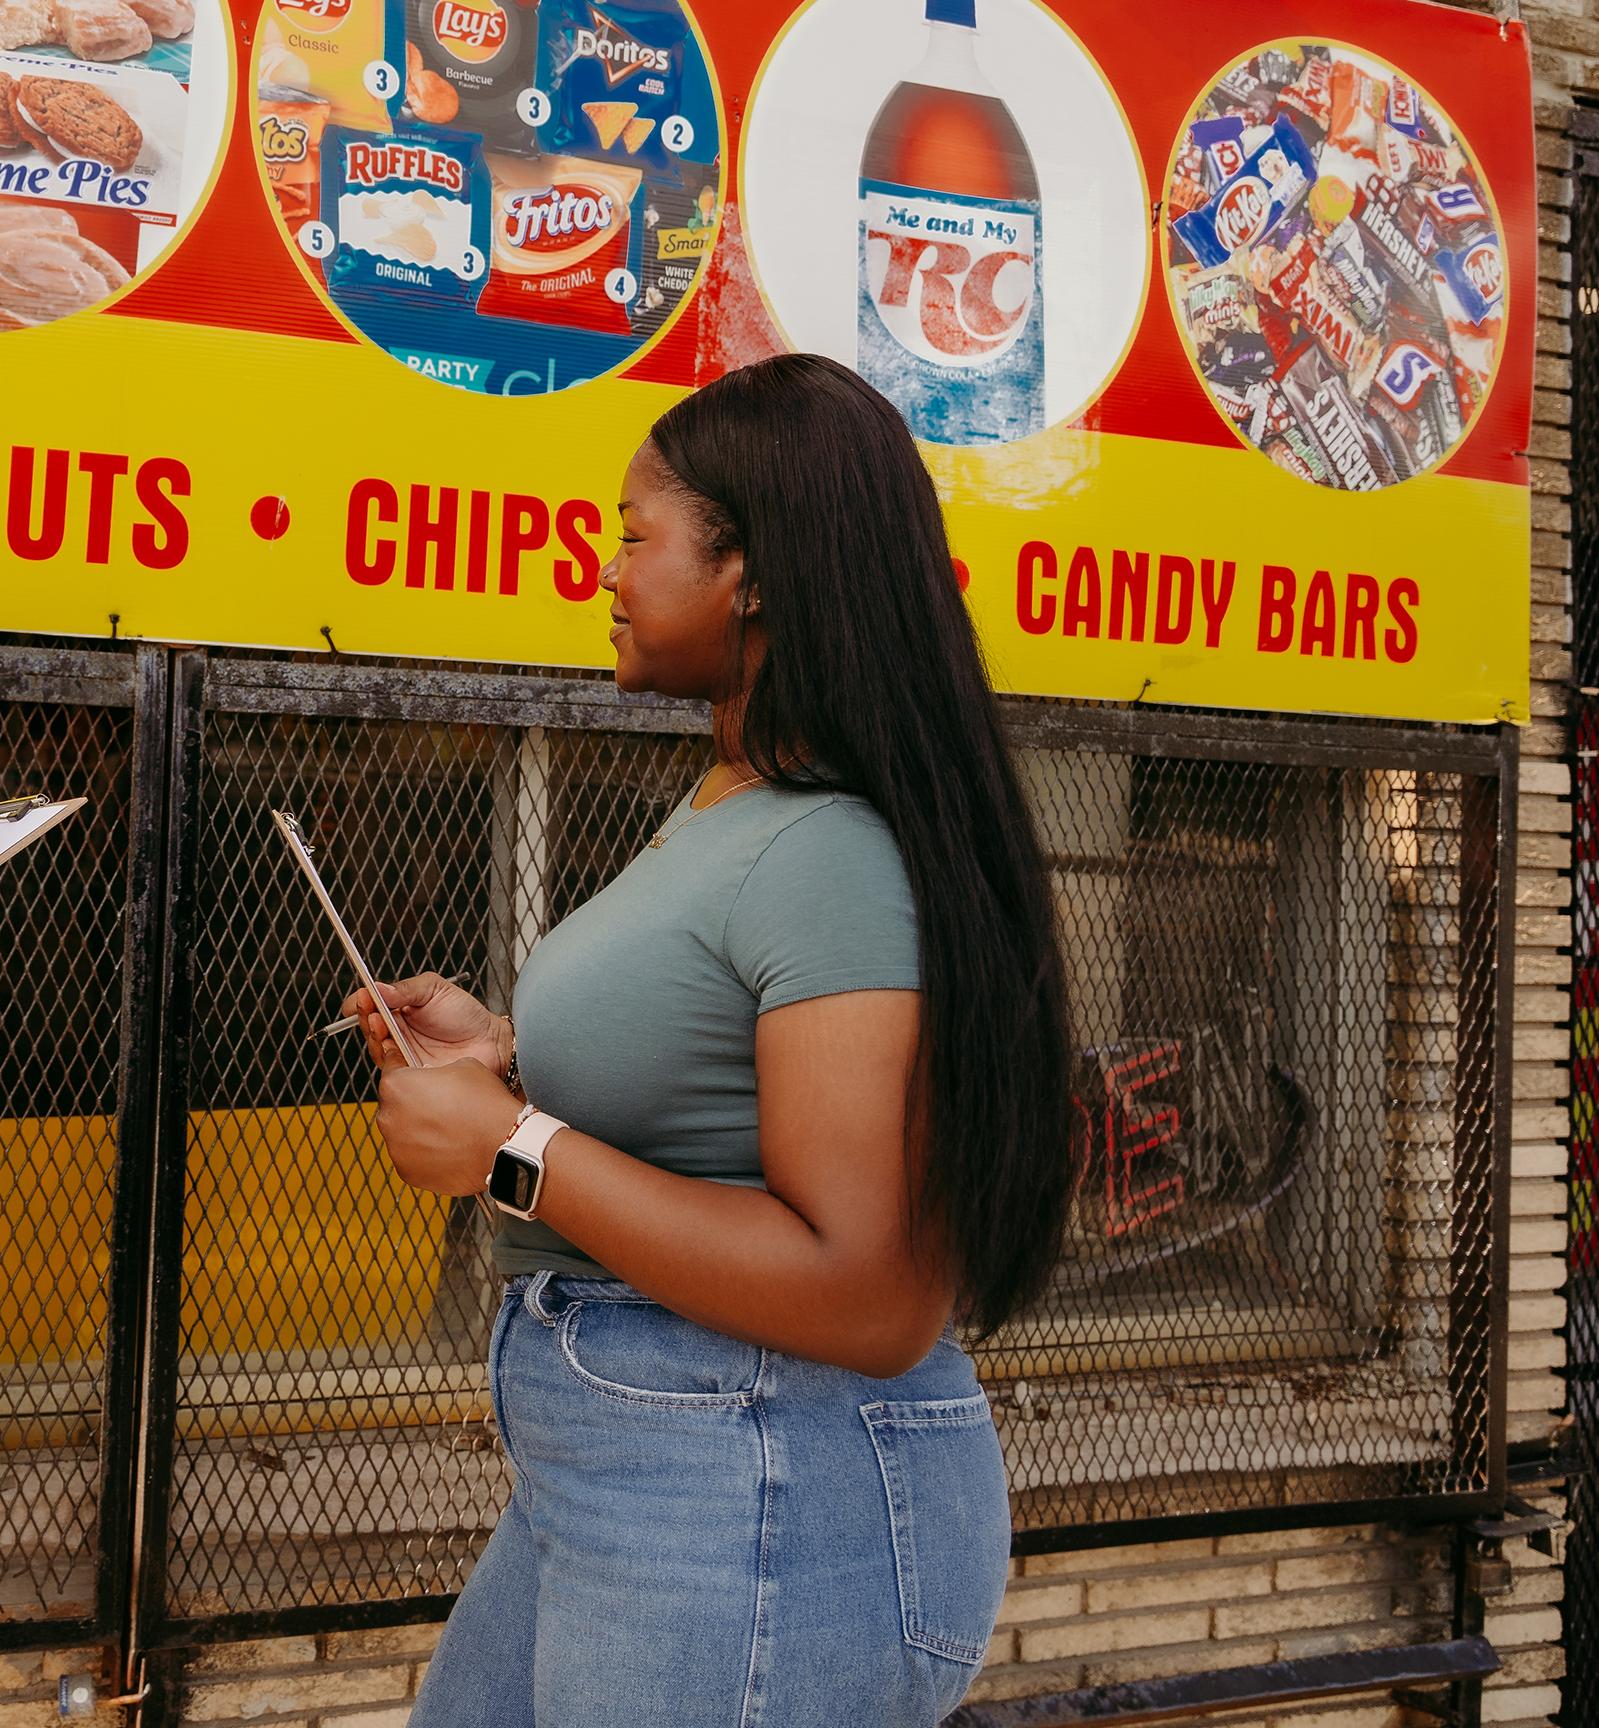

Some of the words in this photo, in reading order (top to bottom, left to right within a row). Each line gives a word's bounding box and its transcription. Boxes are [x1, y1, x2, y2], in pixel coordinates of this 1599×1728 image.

[288, 34, 340, 55] Classic
[576, 29, 670, 72] Doritos
[375, 68, 388, 92] 3
[445, 67, 494, 86] Barbecue
[528, 96, 540, 119] 3
[672, 123, 684, 146] 2
[348, 144, 462, 190] RUFFLES
[58, 159, 151, 208] Pies
[502, 184, 614, 248] Fritos
[885, 205, 920, 230] Me
[925, 215, 975, 238] and
[981, 220, 1018, 246] My
[311, 229, 323, 252] 5
[375, 262, 433, 288] ORIGINAL
[462, 252, 475, 274] 3
[520, 279, 538, 292] The
[539, 267, 597, 292] ORIGINAL
[613, 276, 626, 296] 4
[867, 230, 1034, 357] RC
[1294, 290, 1354, 362] TWIX
[407, 355, 480, 382] PARTY
[1384, 351, 1433, 395] S
[345, 478, 603, 603] CHIPS
[1015, 540, 1237, 649] CANDY
[1256, 564, 1421, 664] BARS
